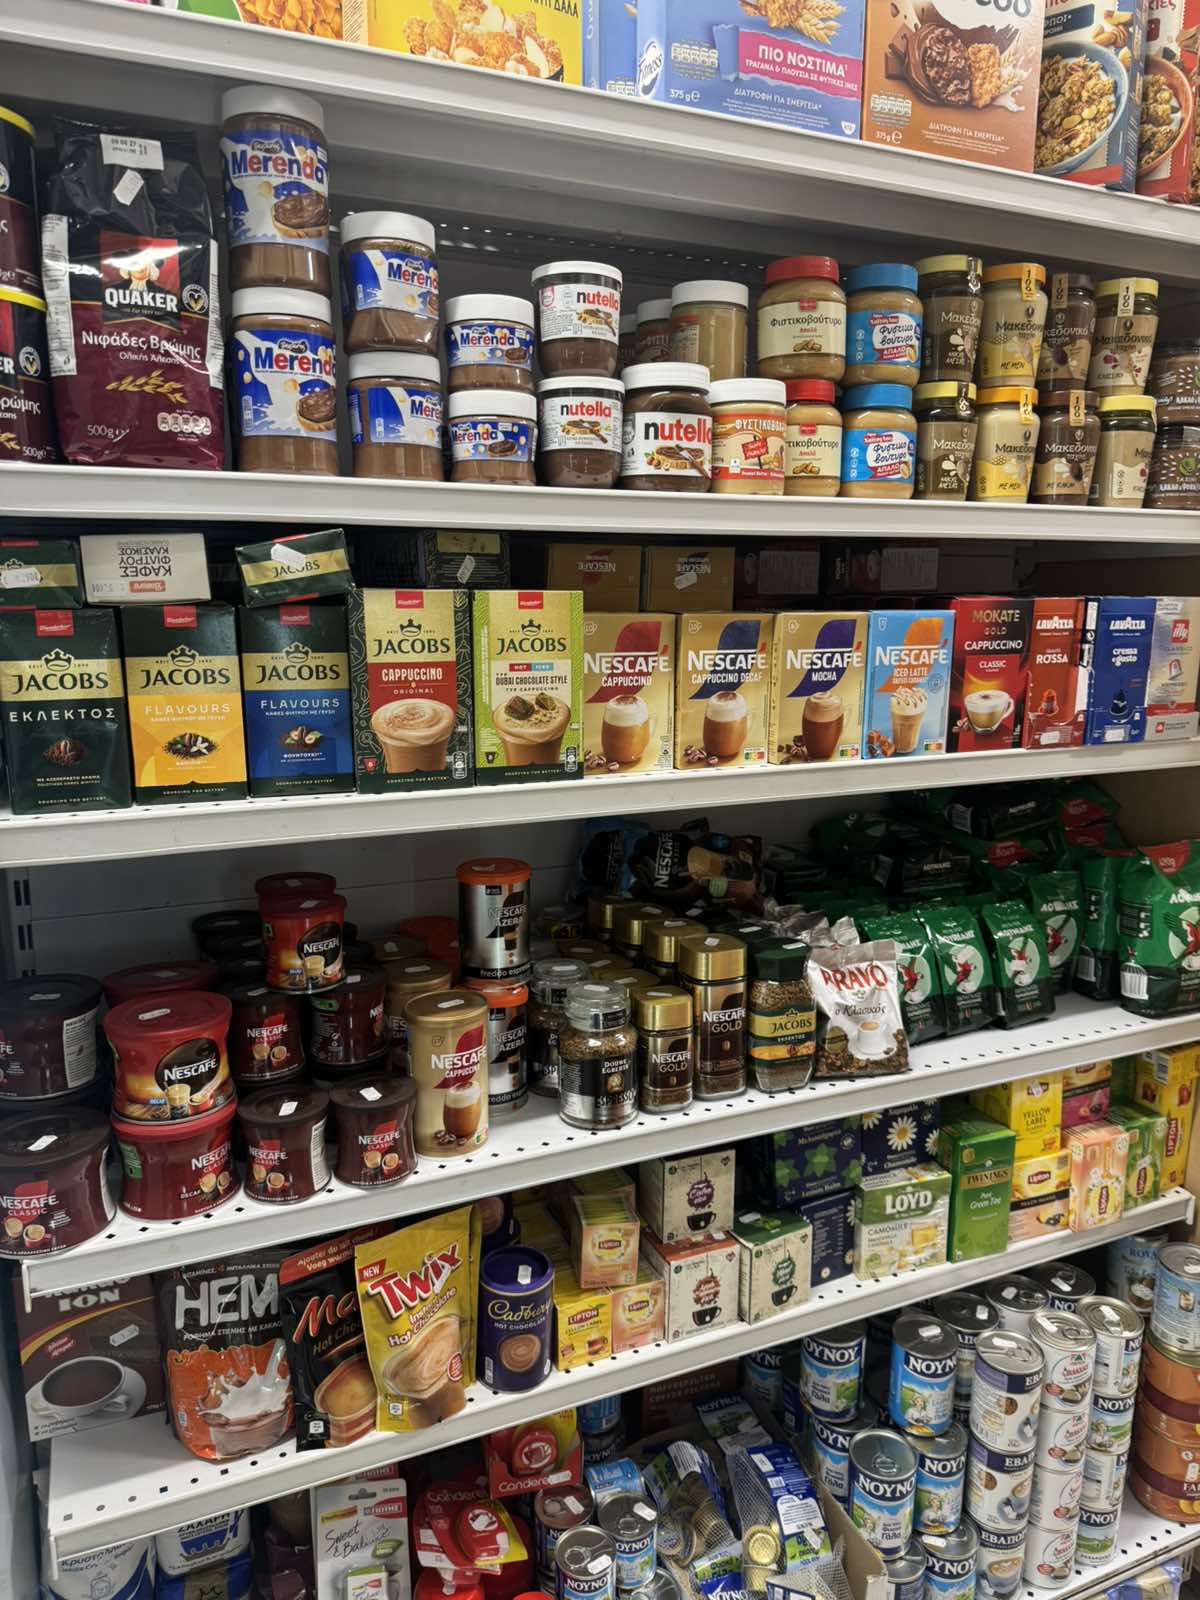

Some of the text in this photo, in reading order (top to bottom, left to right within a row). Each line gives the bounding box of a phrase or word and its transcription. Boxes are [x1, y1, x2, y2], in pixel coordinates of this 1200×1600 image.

[758, 45, 784, 62] ΠΙΟ
[745, 59, 774, 73] ΤΡΑΓΑΝΑ
[781, 67, 809, 79] ΠΛΟΥΣΙΑ
[669, 88, 685, 99] 375
[734, 87, 773, 101] ΔΙΑΤΡΟΦΗ
[774, 95, 785, 104] ΓΙΑ
[928, 122, 961, 134] ΔΙΑΤΡΟΦΗ
[963, 128, 973, 136] ΓΙΑ
[231, 150, 325, 184] Merenda
[387, 262, 439, 290] Meren
[105, 288, 178, 313] QUAKER
[576, 289, 619, 310] nutella
[770, 313, 842, 328] Φιστικοβούτυρο
[460, 330, 515, 347] Merenda
[1045, 327, 1088, 337] κεδονικό
[82, 330, 202, 359] Νιφάδες Βρώμης
[119, 352, 149, 362] Ολικής
[254, 346, 336, 376] Merend
[0, 397, 41, 414] ρώμης
[410, 399, 443, 420] Mere
[560, 401, 612, 418] nutella
[87, 424, 114, 438] 500g
[786, 437, 839, 449] τικοβούτυρο
[119, 547, 169, 556] ΚΛΑΣΙΚΟΣ
[119, 555, 172, 565] ΦΙΛΤΡΟΥ
[119, 566, 172, 577] ΚΑΦΕΣ
[973, 609, 1021, 623] MOKATE
[1036, 616, 1074, 630] LAVAZZA
[1110, 617, 1146, 630] LAVAZZA
[984, 626, 1007, 635] GOLD
[373, 638, 451, 657] JACOBS
[496, 637, 568, 656] JACOBS
[964, 640, 1023, 651] CAPPUCCINO
[1112, 647, 1138, 655] crema
[978, 660, 1007, 669] CLASSIC
[1036, 653, 1069, 665] ROSSA
[141, 668, 231, 690] JACOBS
[256, 664, 341, 684] JACOBS
[382, 667, 443, 682] CAPPUCCINO
[550, 674, 568, 684] STYLE
[691, 671, 763, 684] CAPPUCCINO DECAF
[812, 671, 837, 682] MOCHA
[893, 667, 929, 678] ICED LATTE
[12, 672, 109, 695] JACOBS
[601, 676, 652, 688] CAPPUCCINO
[145, 703, 231, 715] FLAVOURS
[260, 698, 340, 709] FLAVOURS
[9, 707, 116, 722] ΕΚΛΕΚΤΟΣ
[711, 1021, 742, 1033] GOLD
[771, 1018, 813, 1034] JACOBS
[659, 1061, 688, 1073] GOLD
[1023, 1107, 1050, 1118] YELLOW
[1025, 1115, 1047, 1126] LABEL
[885, 1190, 933, 1216] LOYD
[8, 1208, 48, 1217] CLASSIC
[306, 1259, 327, 1272] Voeg
[363, 1267, 381, 1279] NEW
[367, 1242, 463, 1320] Twix
[58, 1288, 120, 1312] ION
[175, 1273, 279, 1331] HEM
[488, 1298, 551, 1321] Cadbury
[568, 1310, 598, 1324] LIPTON
[292, 1291, 358, 1344] Ma
[494, 1316, 546, 1330] HOT CHOCOLATE
[312, 1333, 332, 1356] Hot
[387, 1331, 412, 1348] Hot
[908, 1355, 957, 1375] ΝΟΥΝ
[1098, 1399, 1136, 1411] ΝΟΥΝ
[815, 1422, 850, 1449] ΟΥΝ
[924, 1456, 966, 1474] ΝΟΥΝ
[498, 1476, 551, 1492] Candere
[858, 1472, 916, 1498] ΝΟΥΝΟ
[1080, 1510, 1117, 1524] ΥΝΟΥ
[325, 1520, 360, 1552] Sweet
[615, 1538, 653, 1552] ΟΥΝΟΥ
[927, 1553, 977, 1575] ΟΥΝΟΥ
